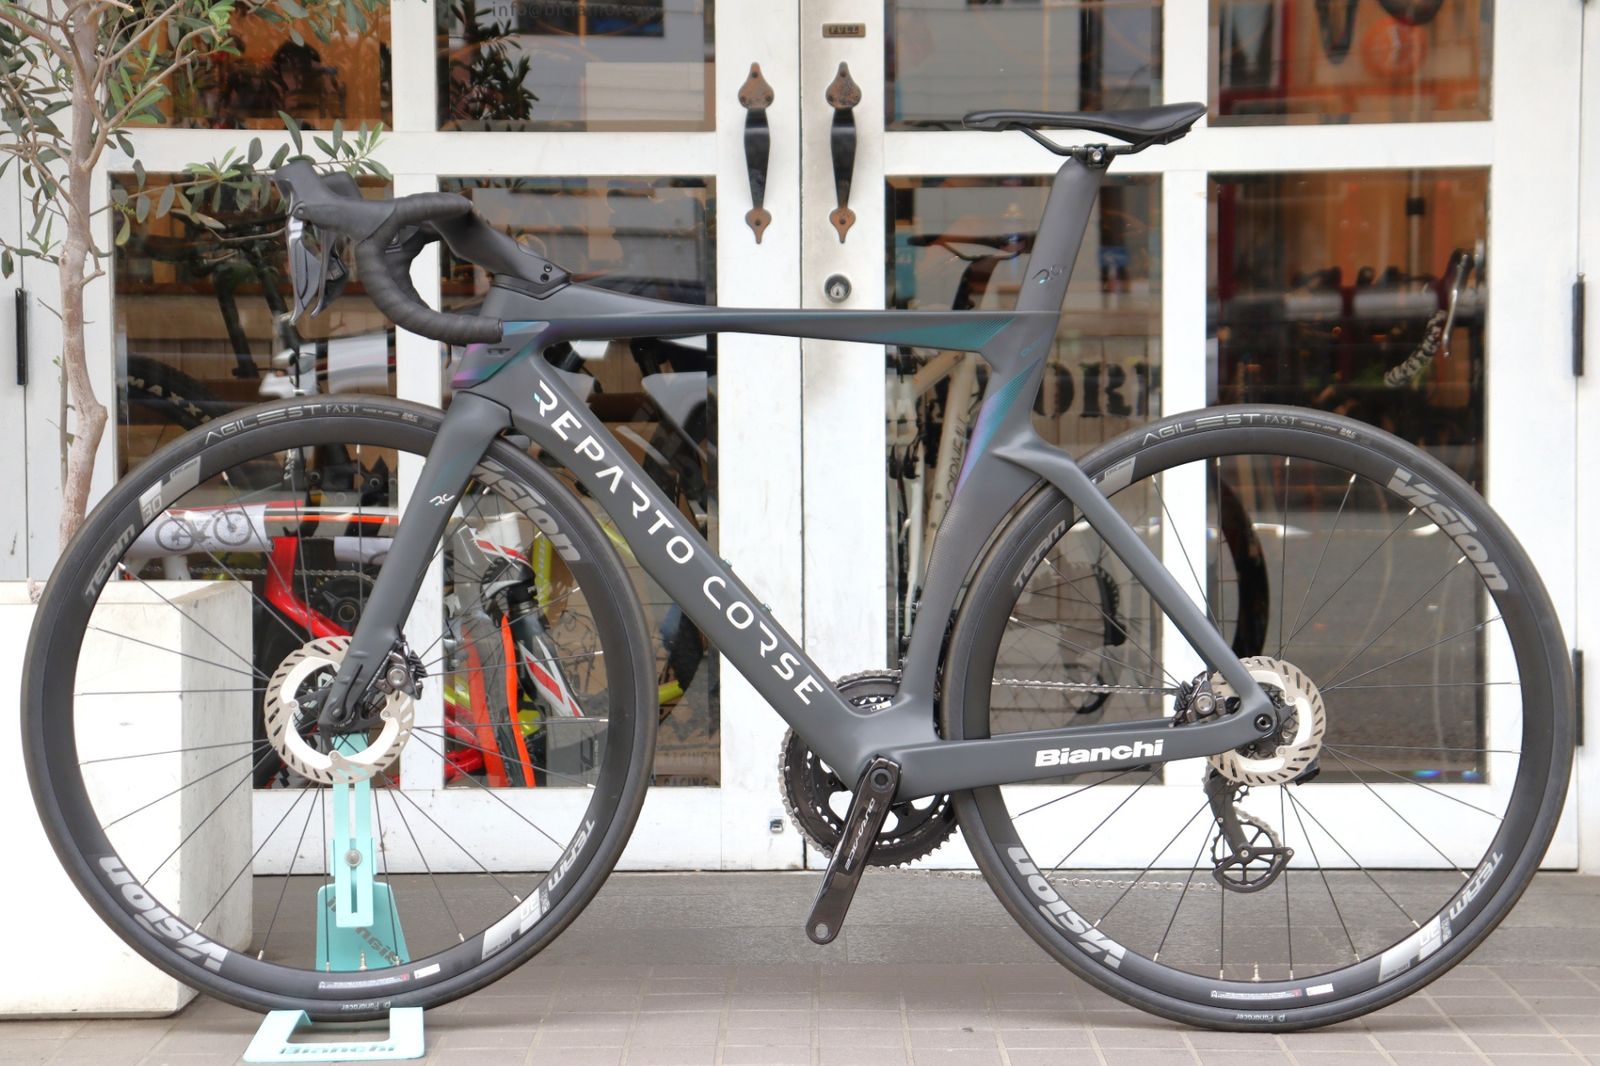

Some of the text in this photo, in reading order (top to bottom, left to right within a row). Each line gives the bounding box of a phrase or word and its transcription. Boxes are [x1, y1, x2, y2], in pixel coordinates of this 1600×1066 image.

[205, 404, 321, 445] AGILEST
[325, 404, 360, 414] FAST
[1142, 413, 1261, 446] AGILEST
[1264, 414, 1298, 426] FAST
[534, 379, 824, 705] REPARTO CORSE
[1034, 739, 1164, 767] Bianchi
[341, 1001, 380, 1010] Panaracer
[1236, 1013, 1274, 1022] Panaracer
